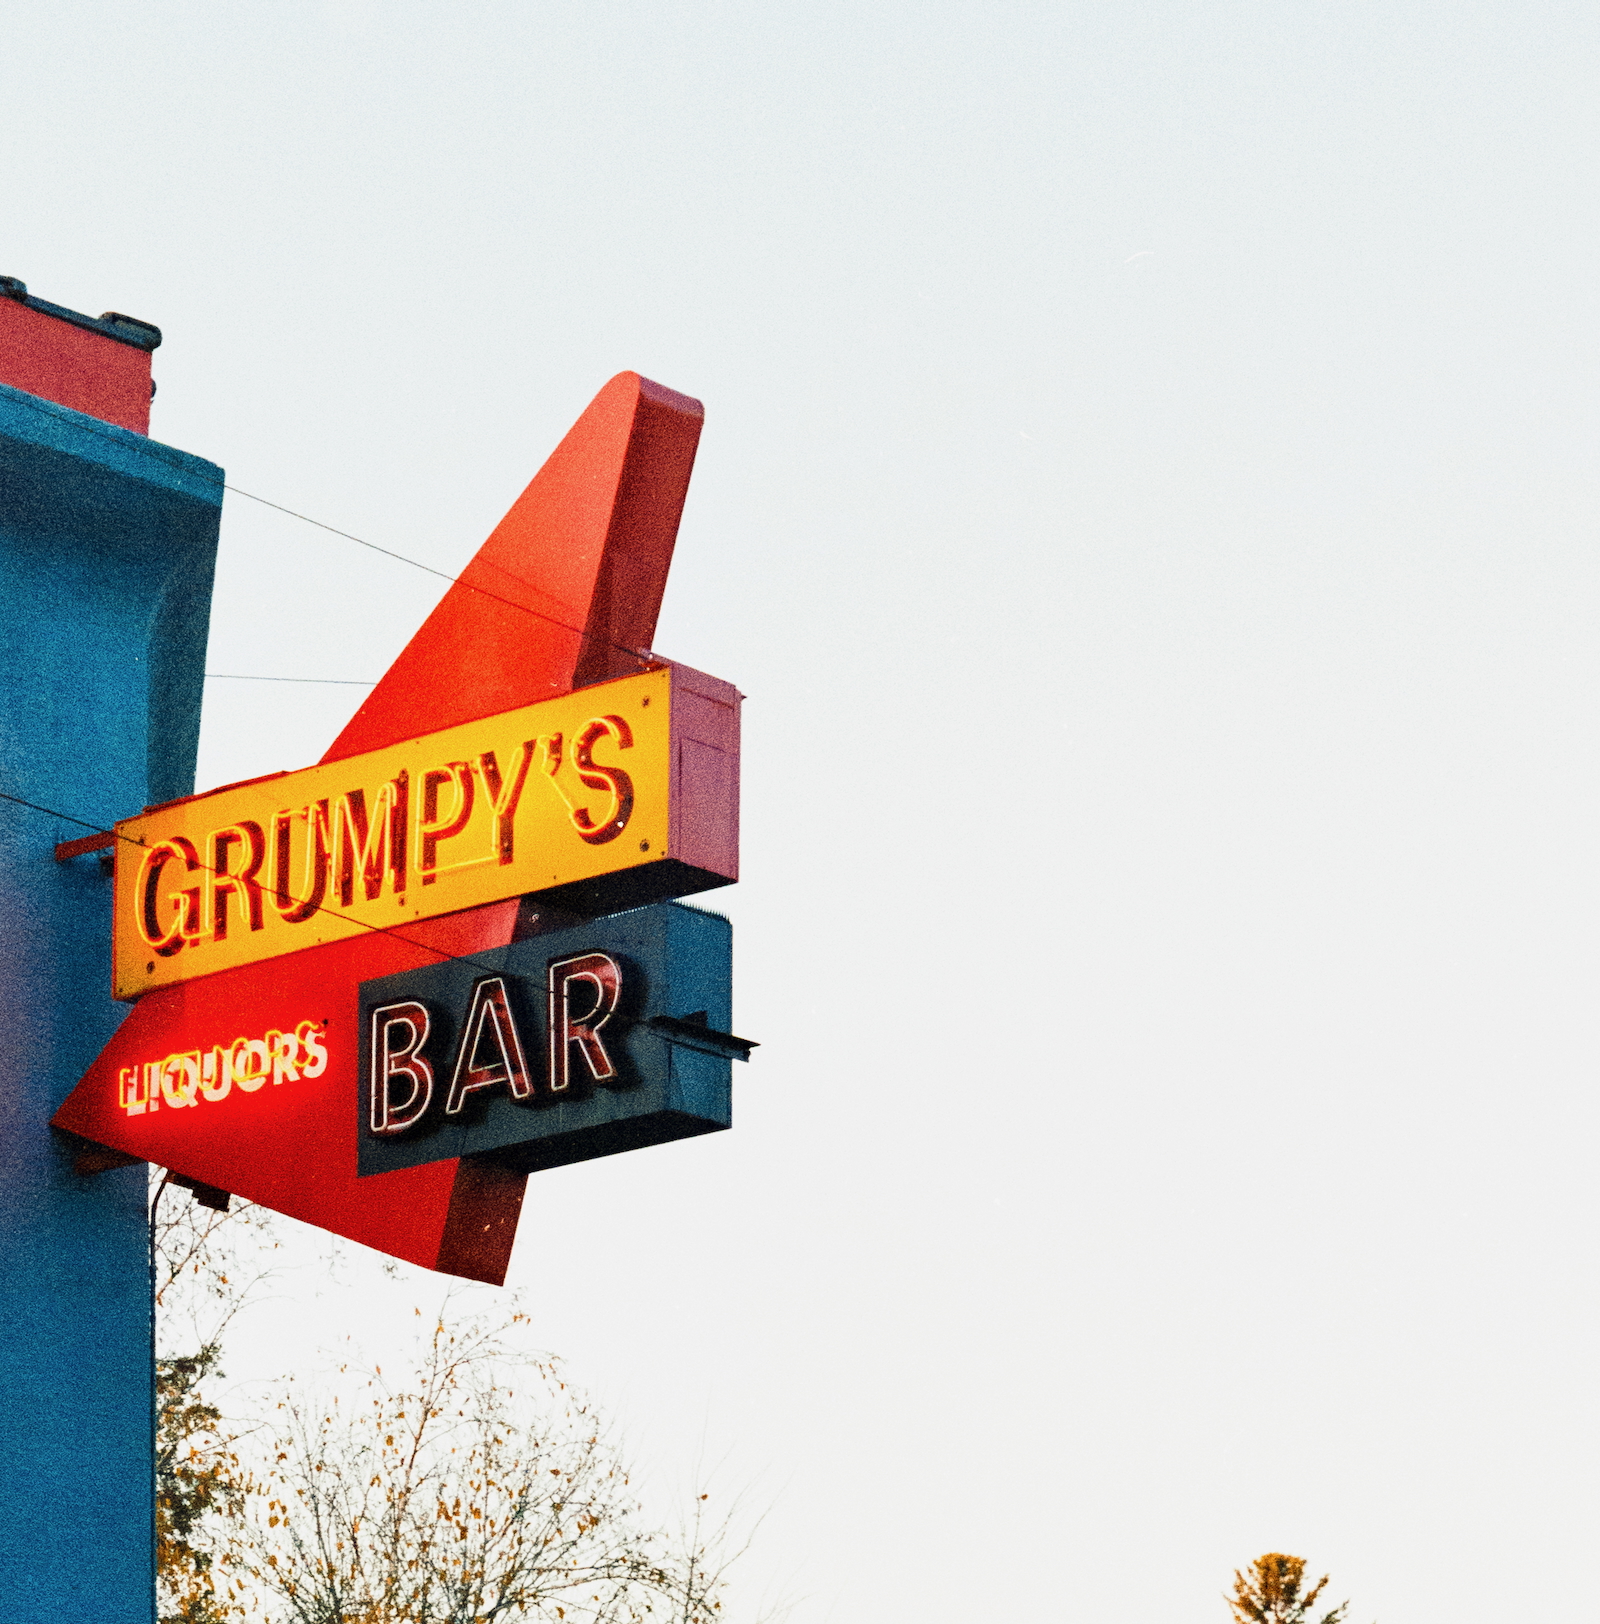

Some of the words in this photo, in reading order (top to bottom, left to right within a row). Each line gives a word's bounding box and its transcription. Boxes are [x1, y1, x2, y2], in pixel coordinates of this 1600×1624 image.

[135, 714, 634, 956] GRUMPY'S
[119, 1020, 328, 1117] LIQUORS
[368, 950, 622, 1133] BAR
